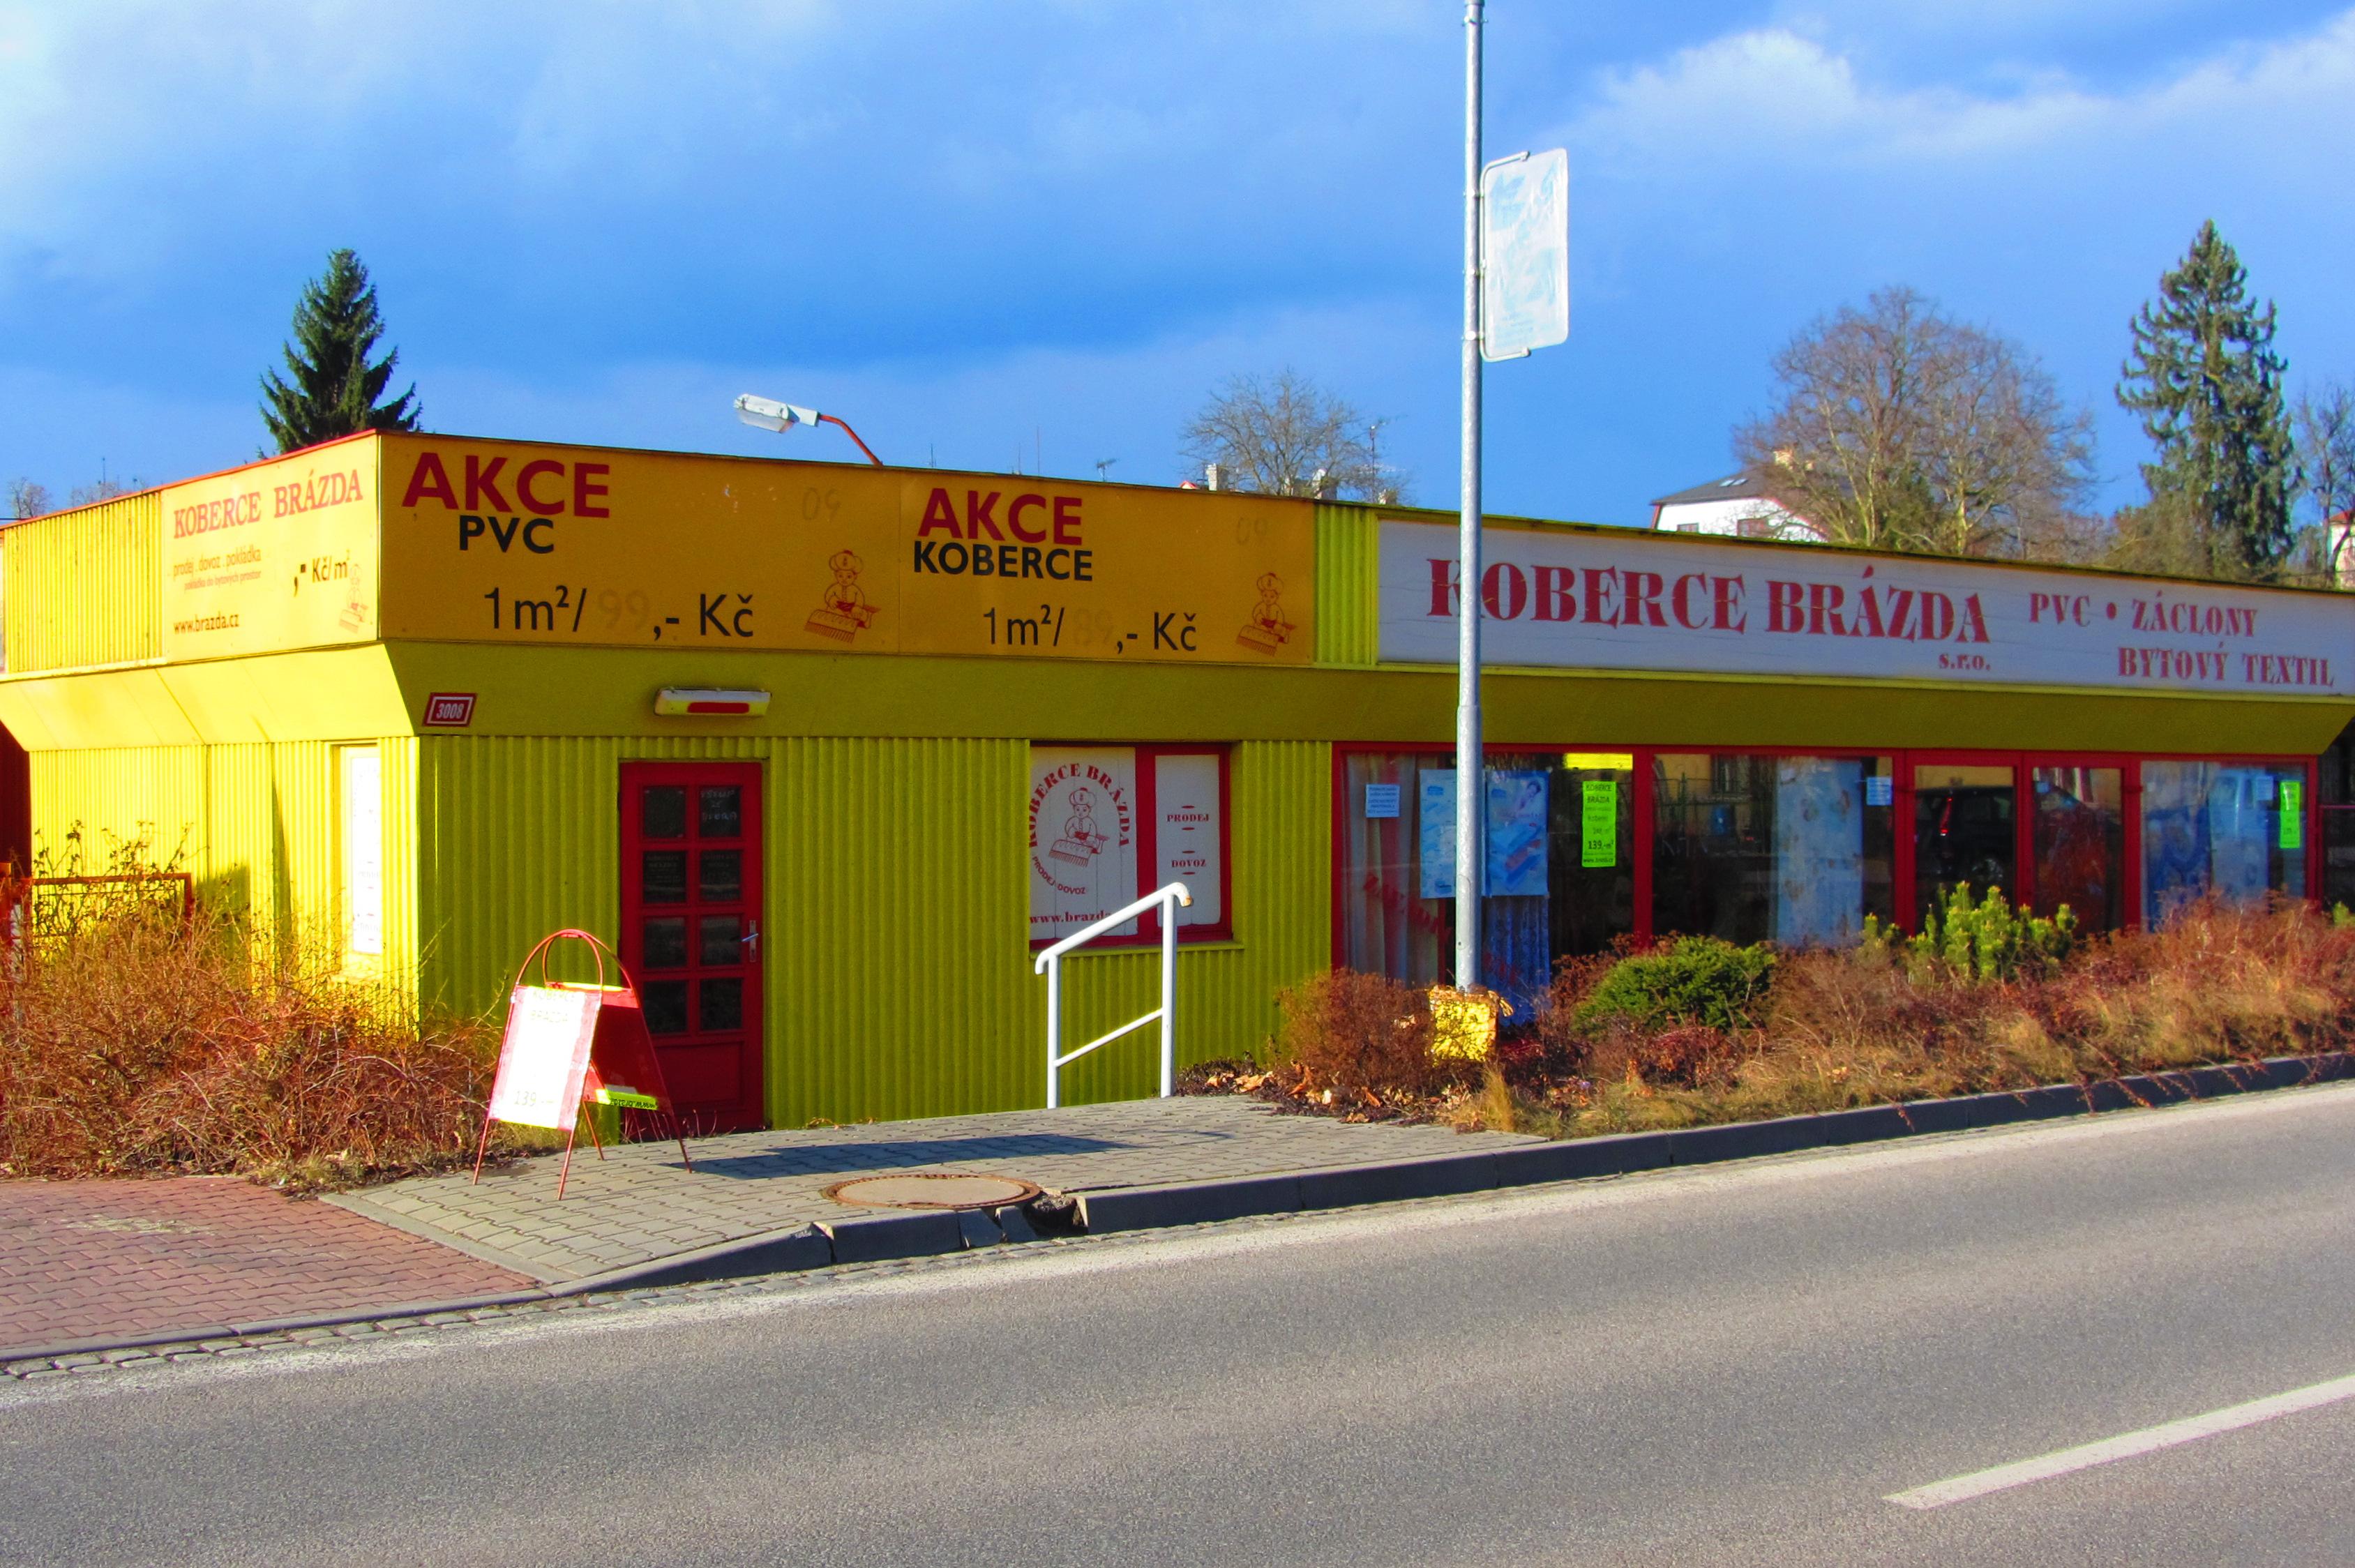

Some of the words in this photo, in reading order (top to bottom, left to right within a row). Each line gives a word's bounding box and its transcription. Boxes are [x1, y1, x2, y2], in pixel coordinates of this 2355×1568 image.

[174, 491, 262, 539] KOBERCE
[274, 468, 363, 518] BRÁZDA
[401, 452, 610, 518] AKCE
[459, 514, 555, 555] PVC
[917, 488, 1083, 546] AKCE
[913, 541, 1093, 582] KOBERCE
[699, 593, 755, 638] Kč
[1426, 559, 1747, 633] KOBERCE
[1766, 565, 1991, 644] BRÁZDA
[2029, 591, 2091, 628] PVC
[2131, 589, 2259, 638] ZÁCLONY
[173, 611, 240, 635] www.brazda.cz
[1153, 612, 1197, 652] Kč
[1939, 653, 1992, 672] s.r.o.
[2118, 641, 2229, 681] BYTOVÝ
[2241, 653, 2336, 688] TEXTIL
[1029, 763, 1081, 848] KOBERCE
[1167, 814, 1210, 822] PRODEJ
[1032, 855, 1055, 887] PRODEJ
[1058, 883, 1086, 895] DOVOZ
[1171, 859, 1206, 868] DOVOZ
[1029, 910, 1111, 924] www.brazd
